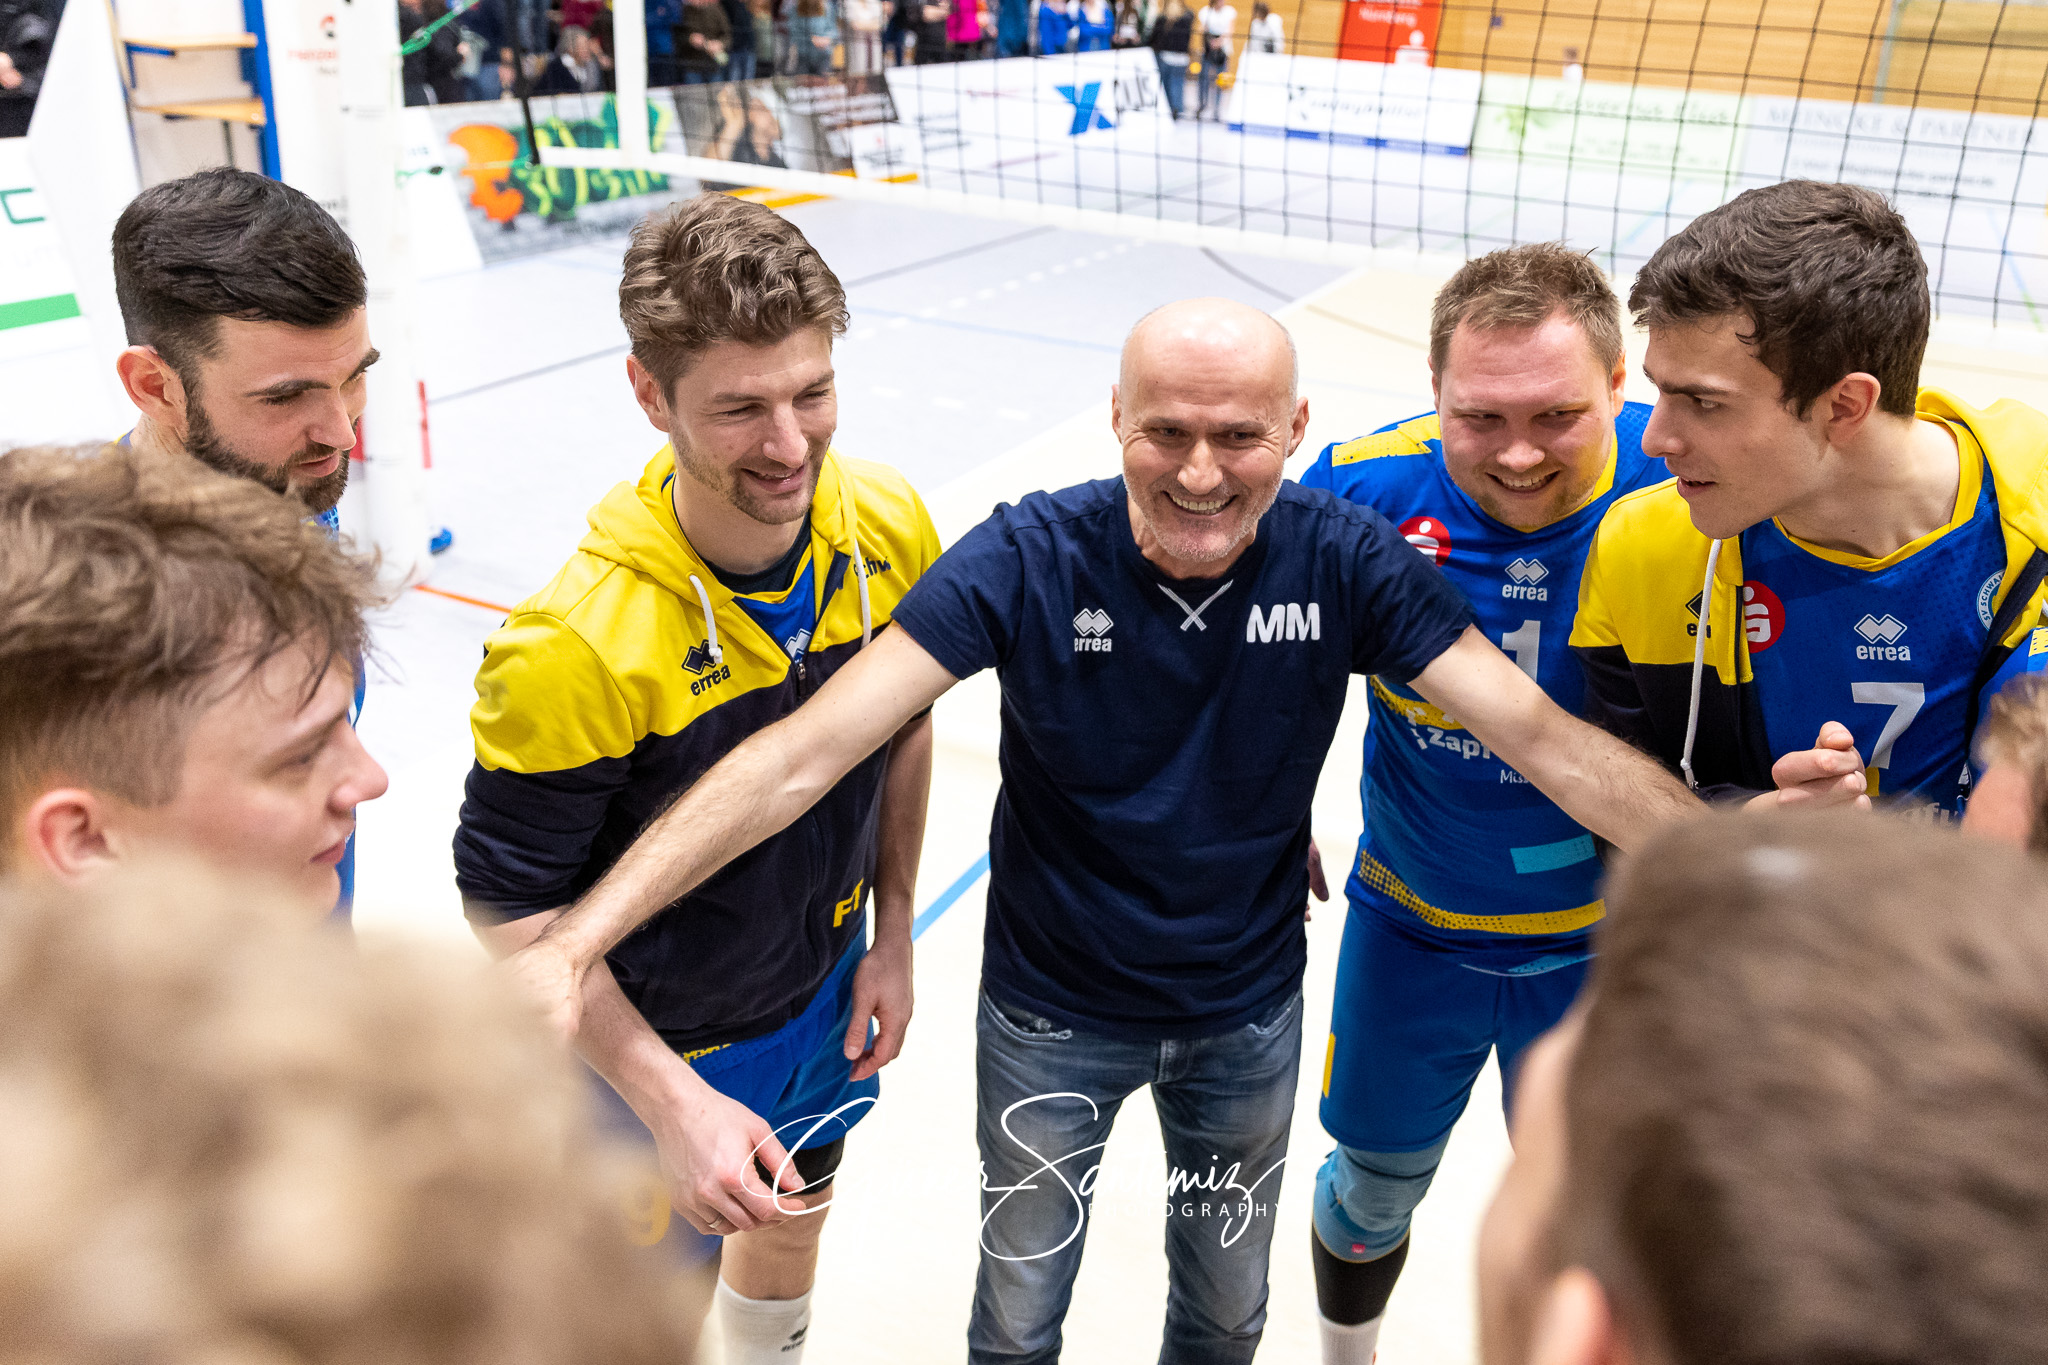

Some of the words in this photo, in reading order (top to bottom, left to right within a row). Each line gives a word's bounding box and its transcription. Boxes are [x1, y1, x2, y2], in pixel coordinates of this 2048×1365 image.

[1980, 571, 2005, 607] SCHWA
[1246, 602, 1321, 643] MM
[1501, 619, 1541, 683] 1
[1851, 682, 1926, 770] 7
